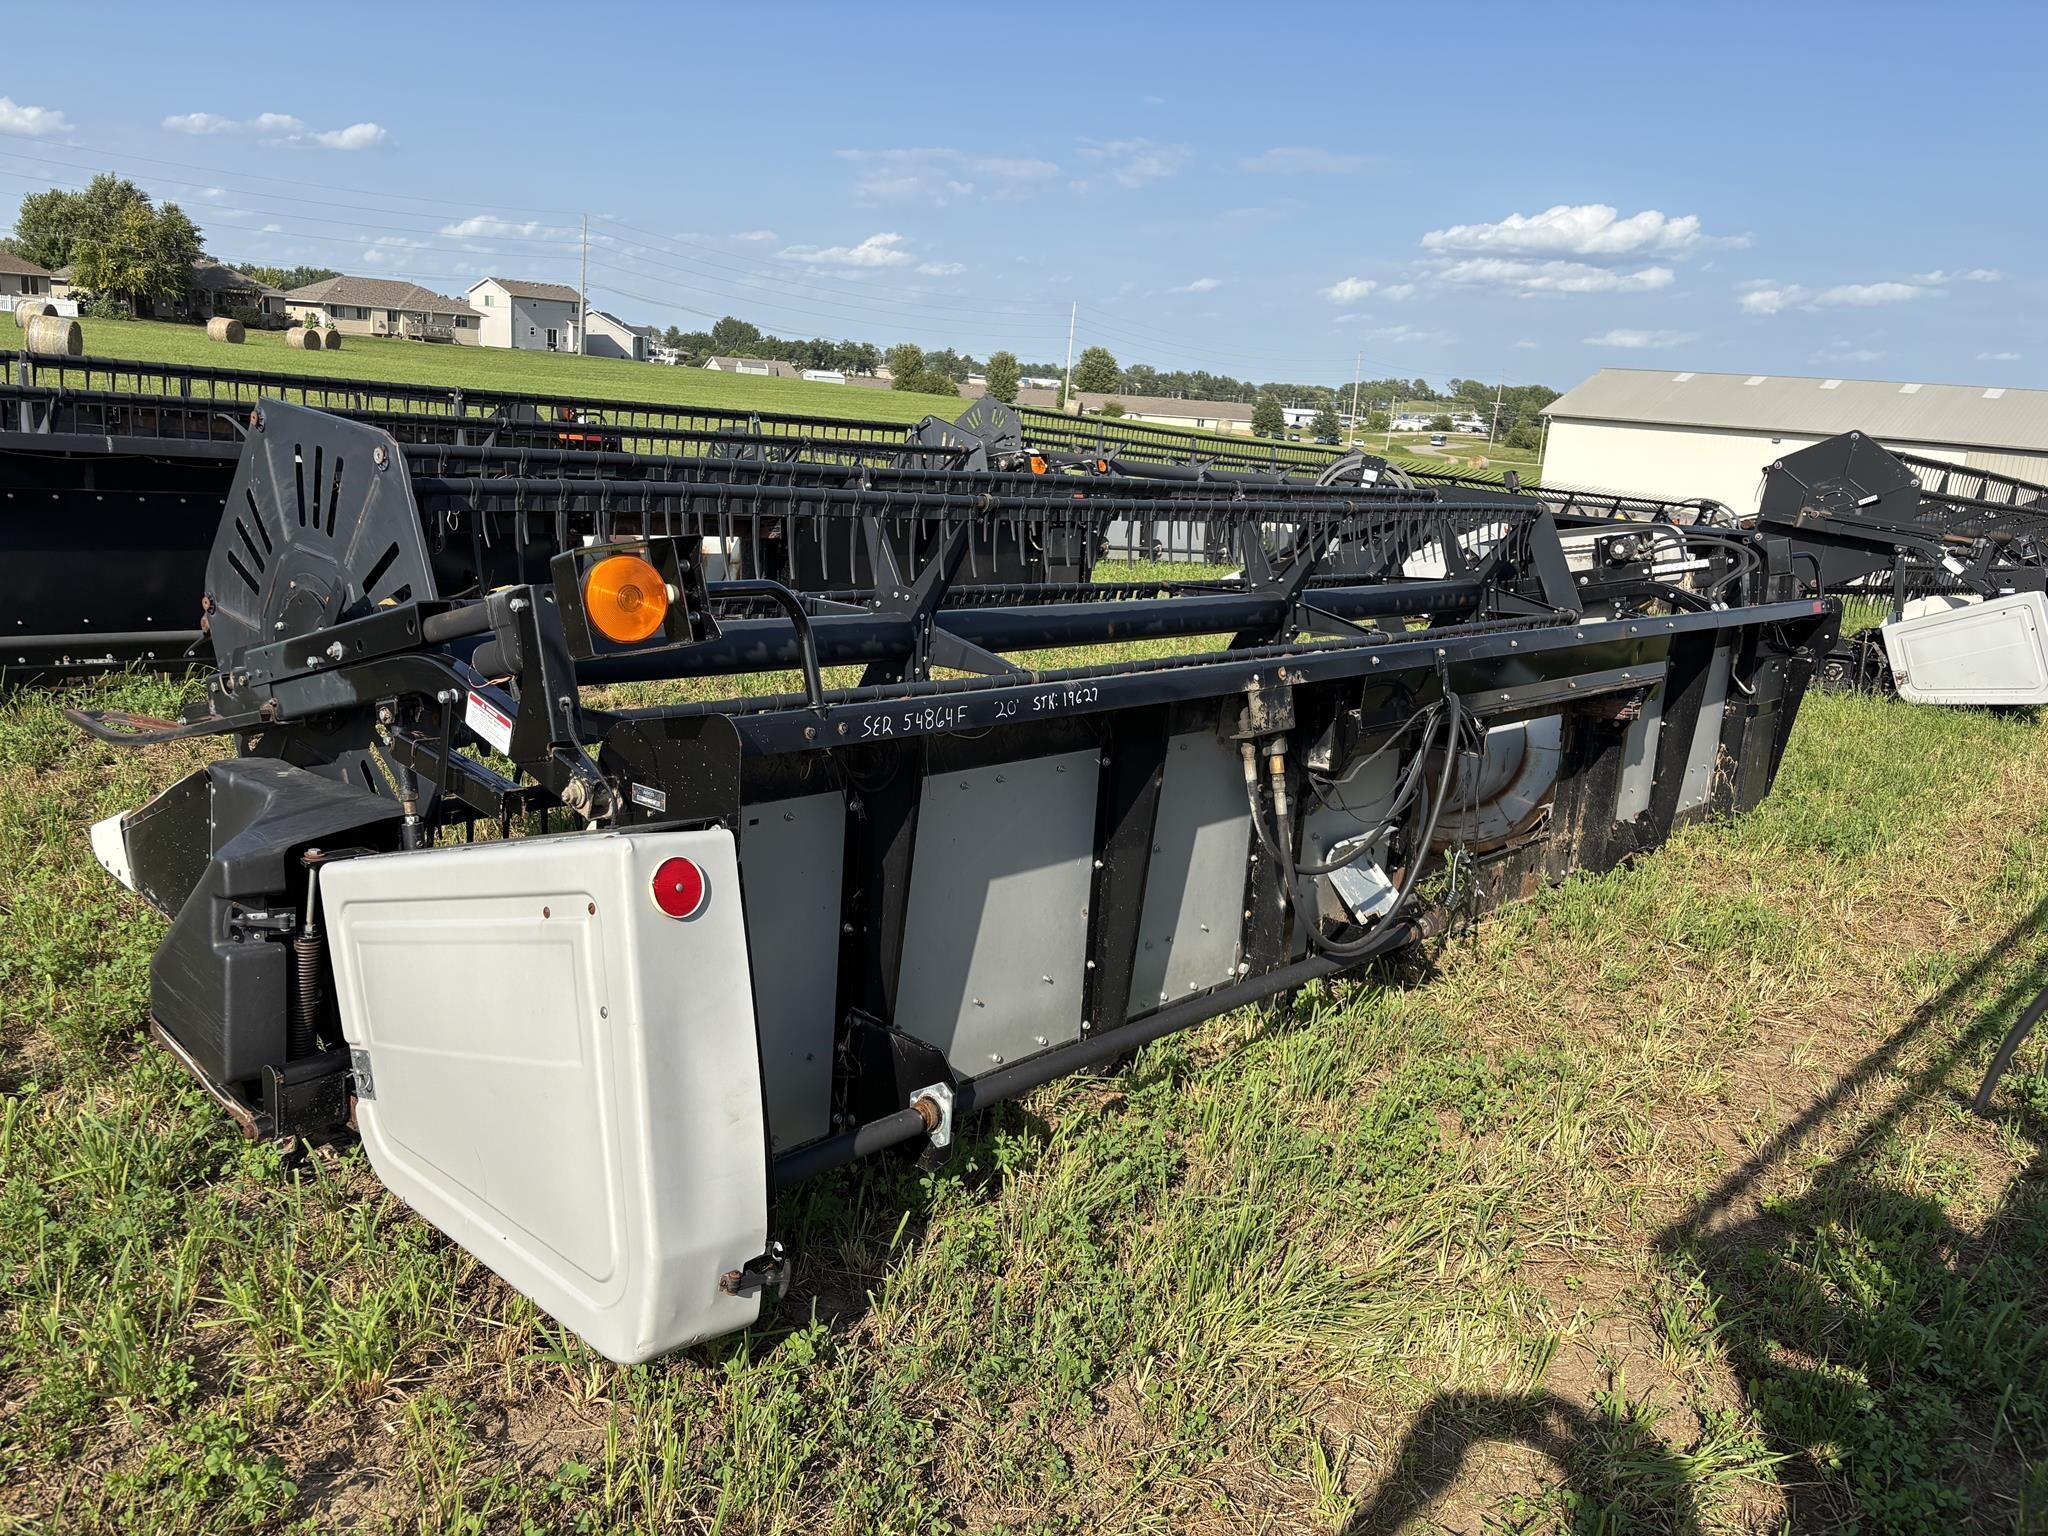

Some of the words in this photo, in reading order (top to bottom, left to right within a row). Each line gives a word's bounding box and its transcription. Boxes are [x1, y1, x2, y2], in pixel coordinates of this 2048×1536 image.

[861, 715, 893, 738] SER
[903, 705, 968, 731] 54864F
[1063, 687, 1099, 707] 19627
